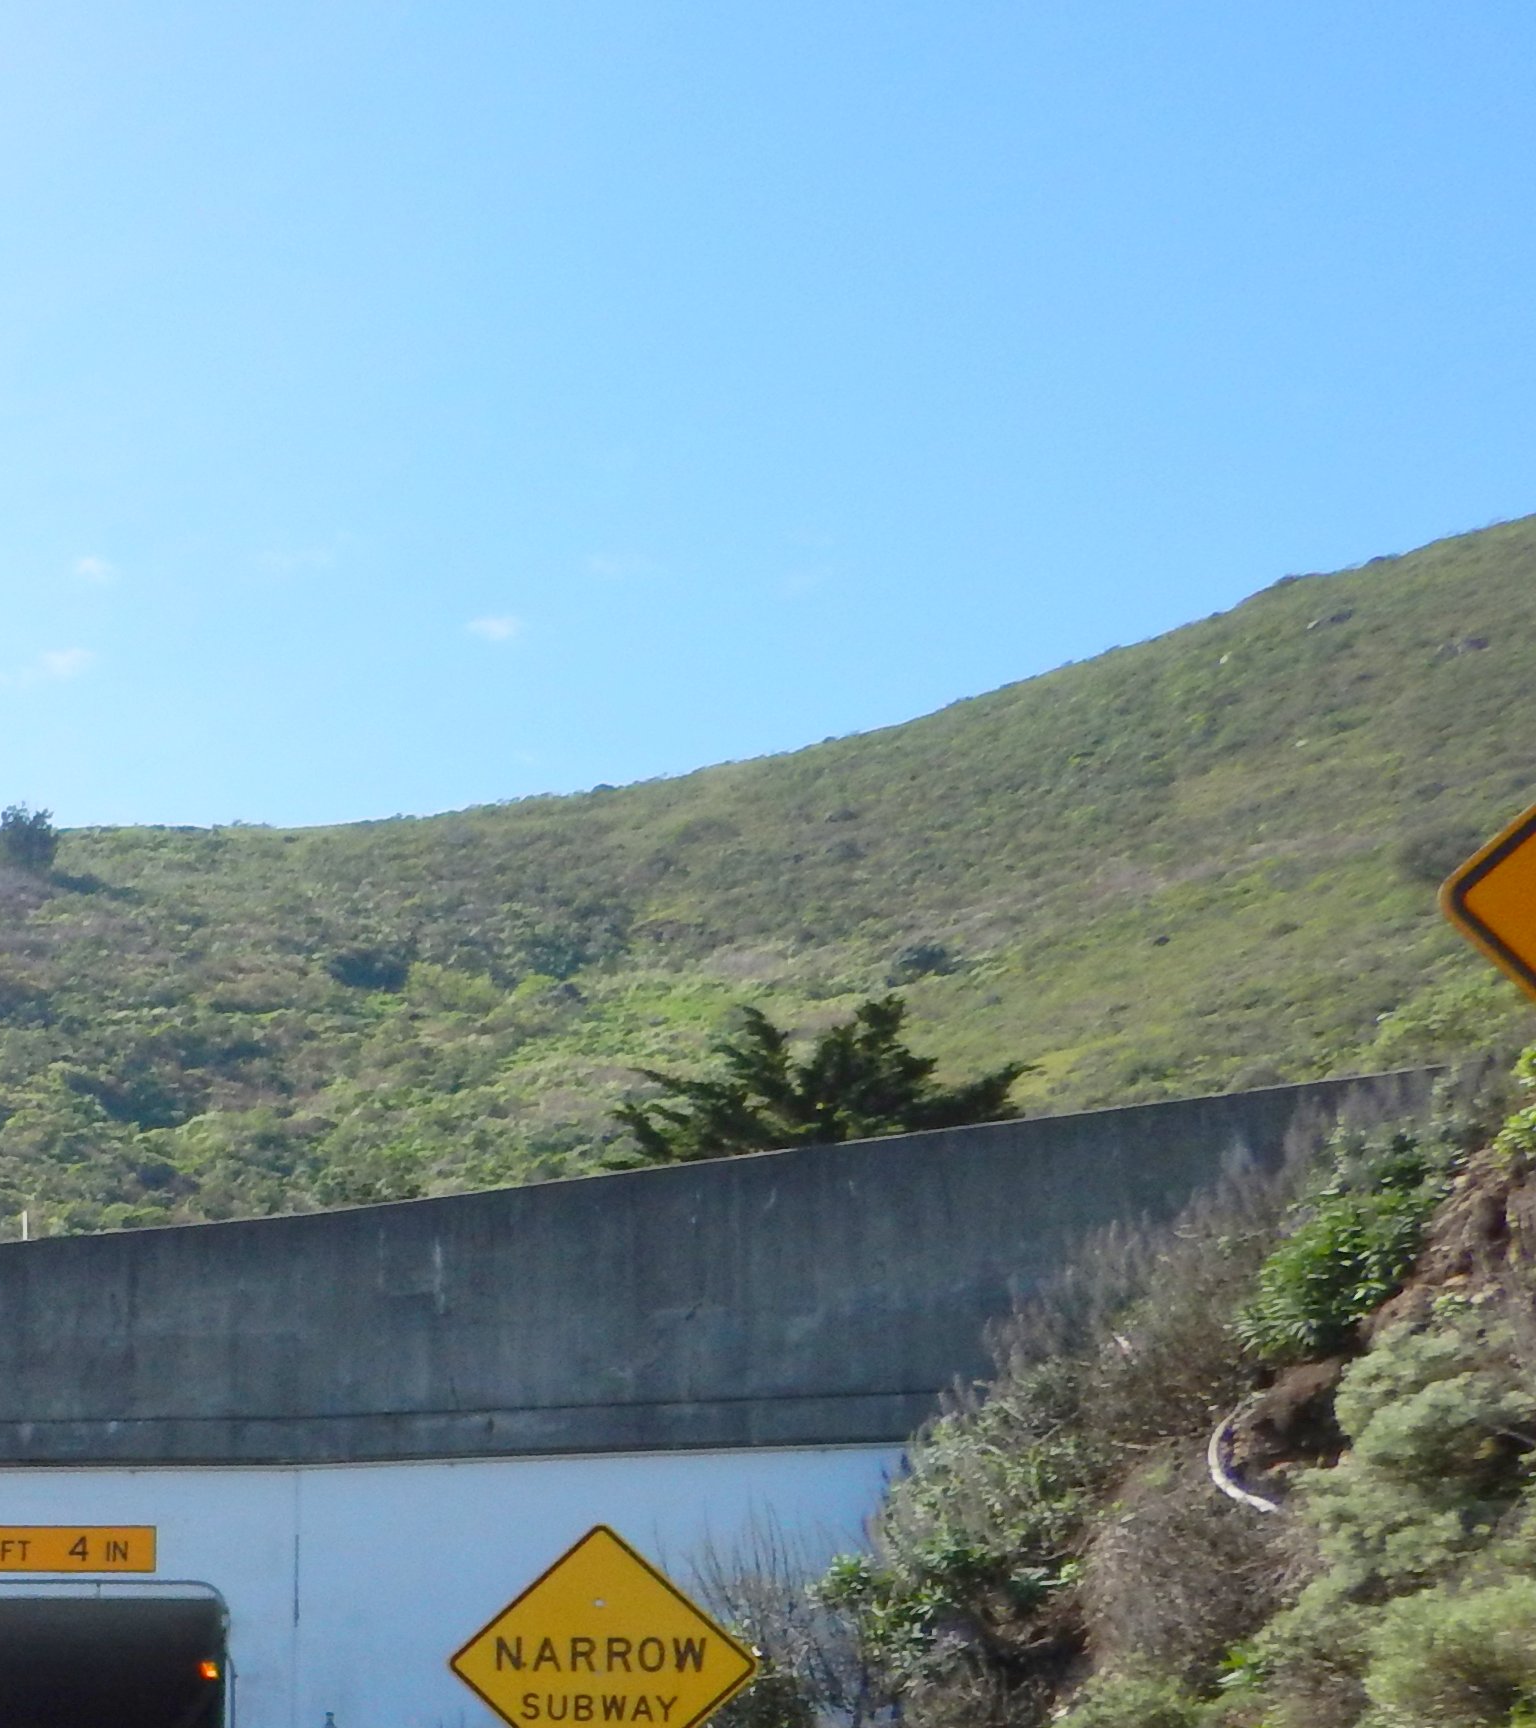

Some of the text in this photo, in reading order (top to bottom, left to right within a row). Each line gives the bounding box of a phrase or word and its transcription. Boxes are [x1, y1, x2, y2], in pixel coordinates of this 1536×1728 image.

[1, 1540, 31, 1562] FT
[68, 1536, 89, 1562] 4
[106, 1541, 128, 1562] IN
[495, 1637, 706, 1673] NARROW
[521, 1693, 678, 1721] SUBWAY
